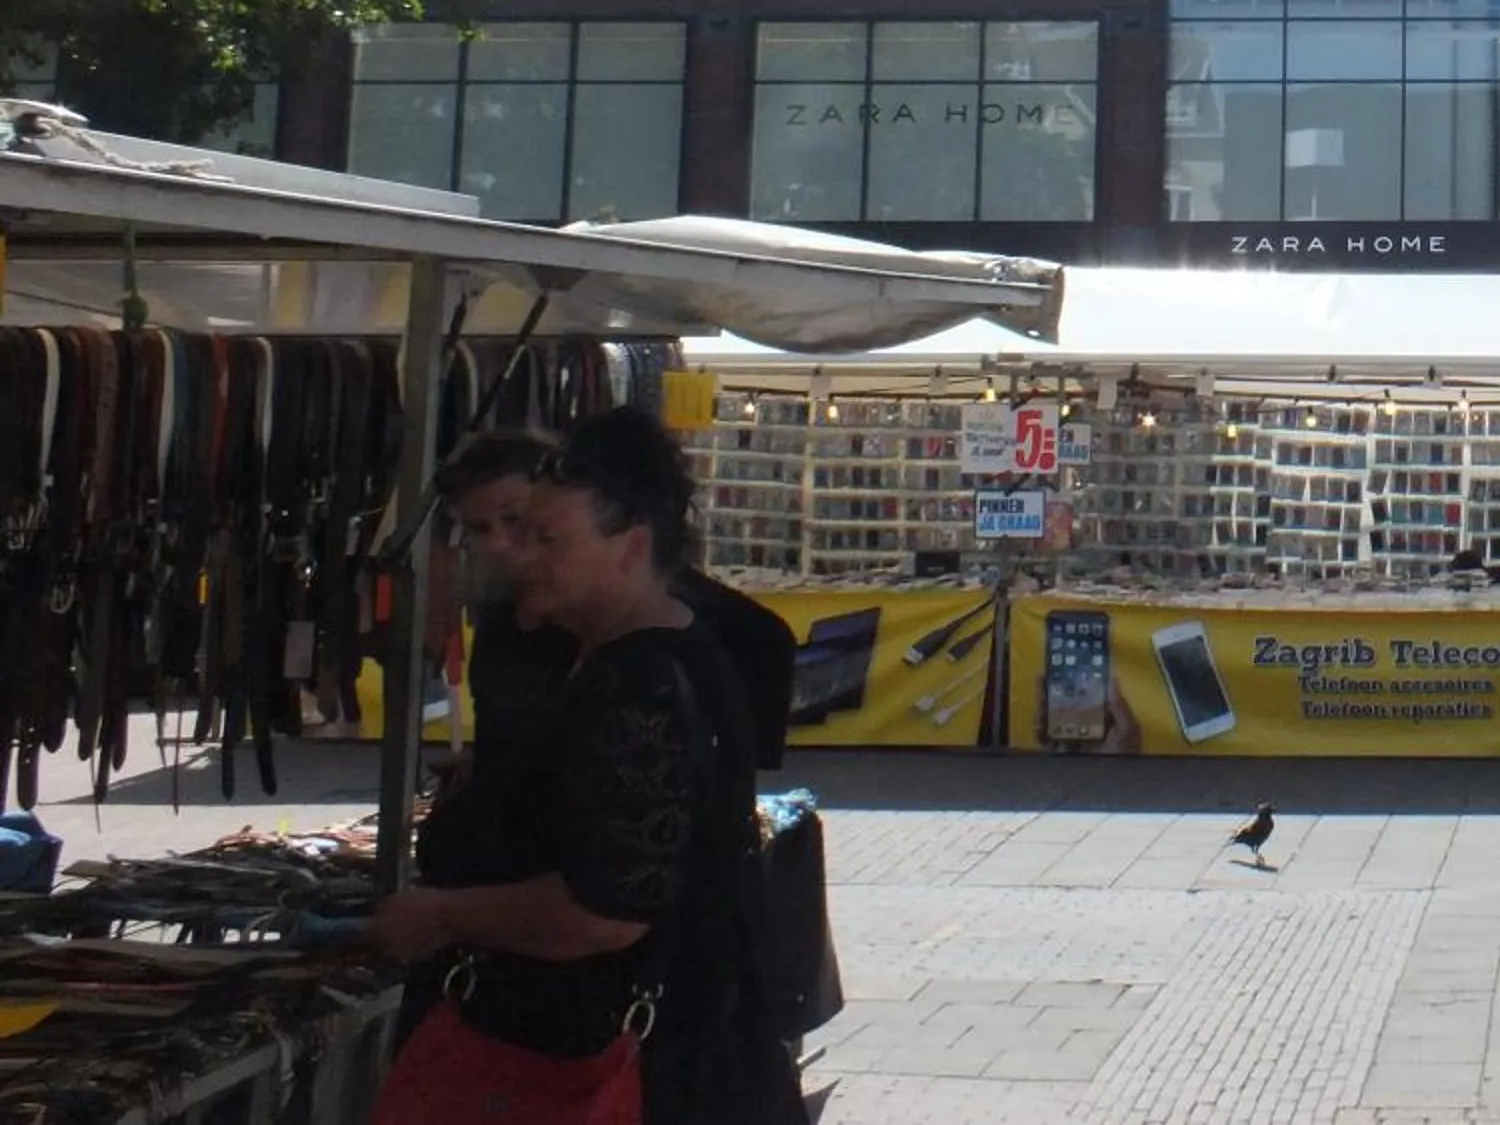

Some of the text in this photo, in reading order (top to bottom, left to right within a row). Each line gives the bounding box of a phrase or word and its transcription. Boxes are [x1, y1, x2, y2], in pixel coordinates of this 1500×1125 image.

[786, 103, 1075, 125] ZARA HOME
[1231, 236, 1446, 253] ZARA HOME
[1253, 637, 1376, 674] Zagrib
[1298, 675, 1384, 693] Telefoon
[1302, 700, 1388, 718] Telefoon
